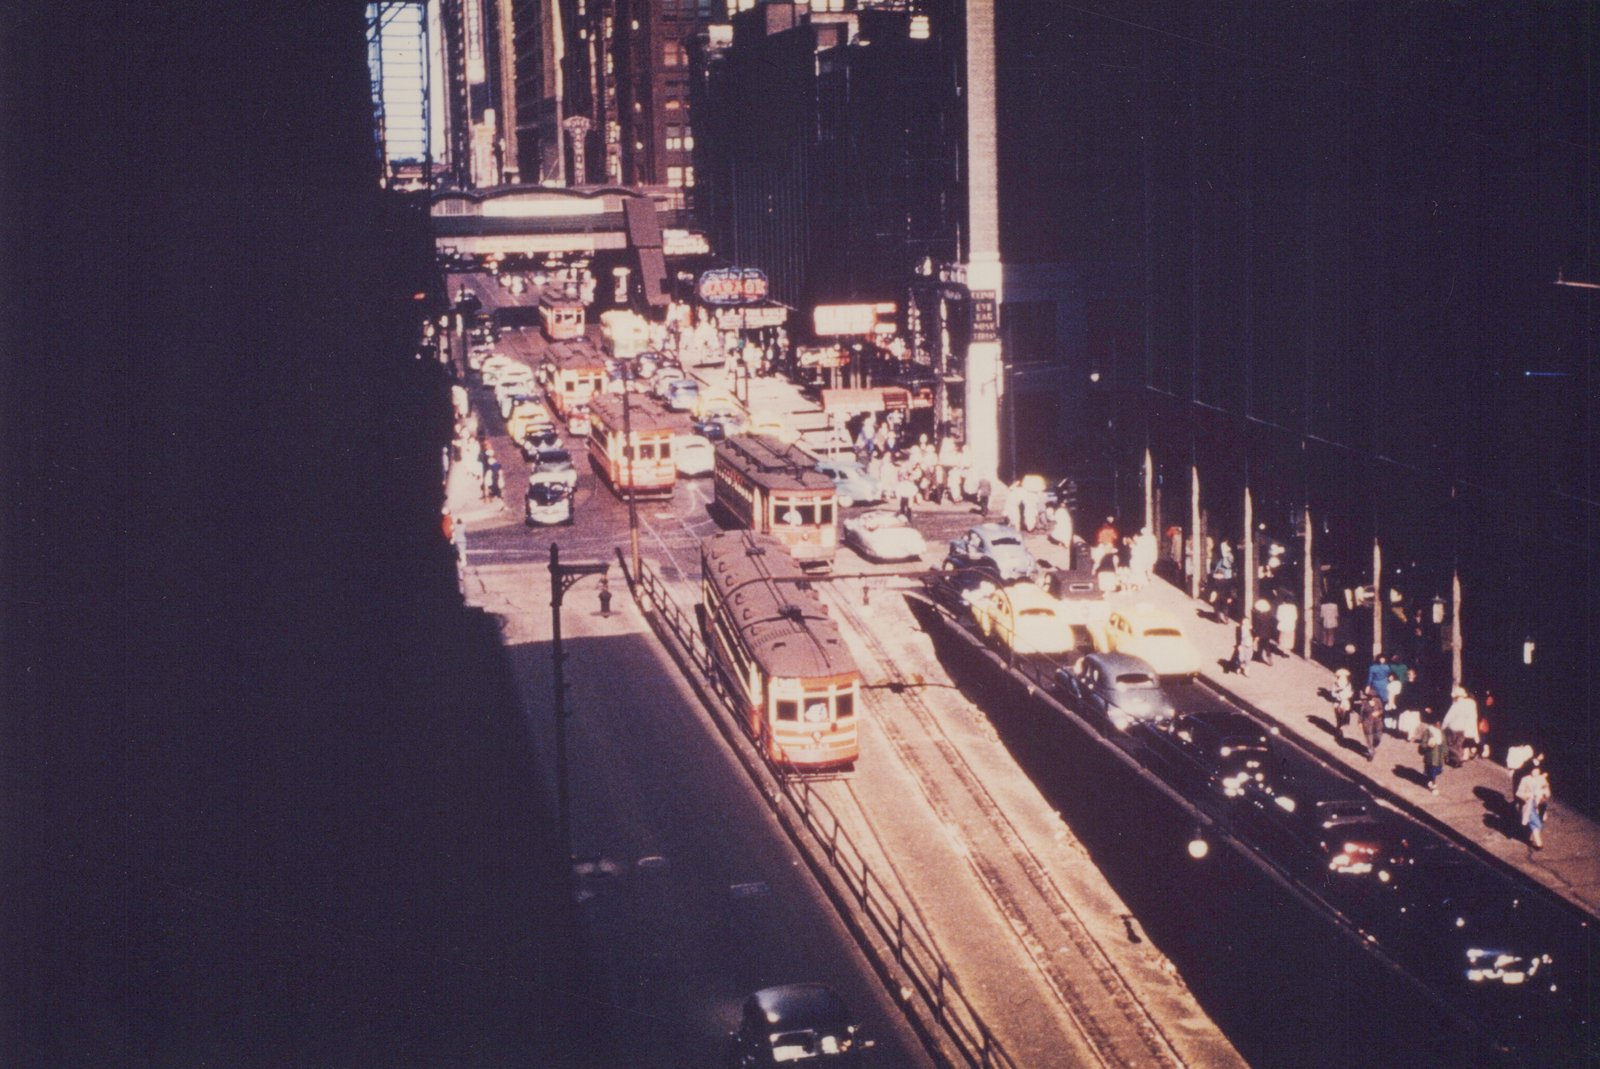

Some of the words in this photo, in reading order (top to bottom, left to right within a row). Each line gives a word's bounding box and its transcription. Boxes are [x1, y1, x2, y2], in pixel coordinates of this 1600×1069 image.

[702, 279, 766, 295] GARAGE
[975, 302, 992, 311] EYE
[975, 312, 992, 321] EAR
[973, 322, 995, 330] NOSE
